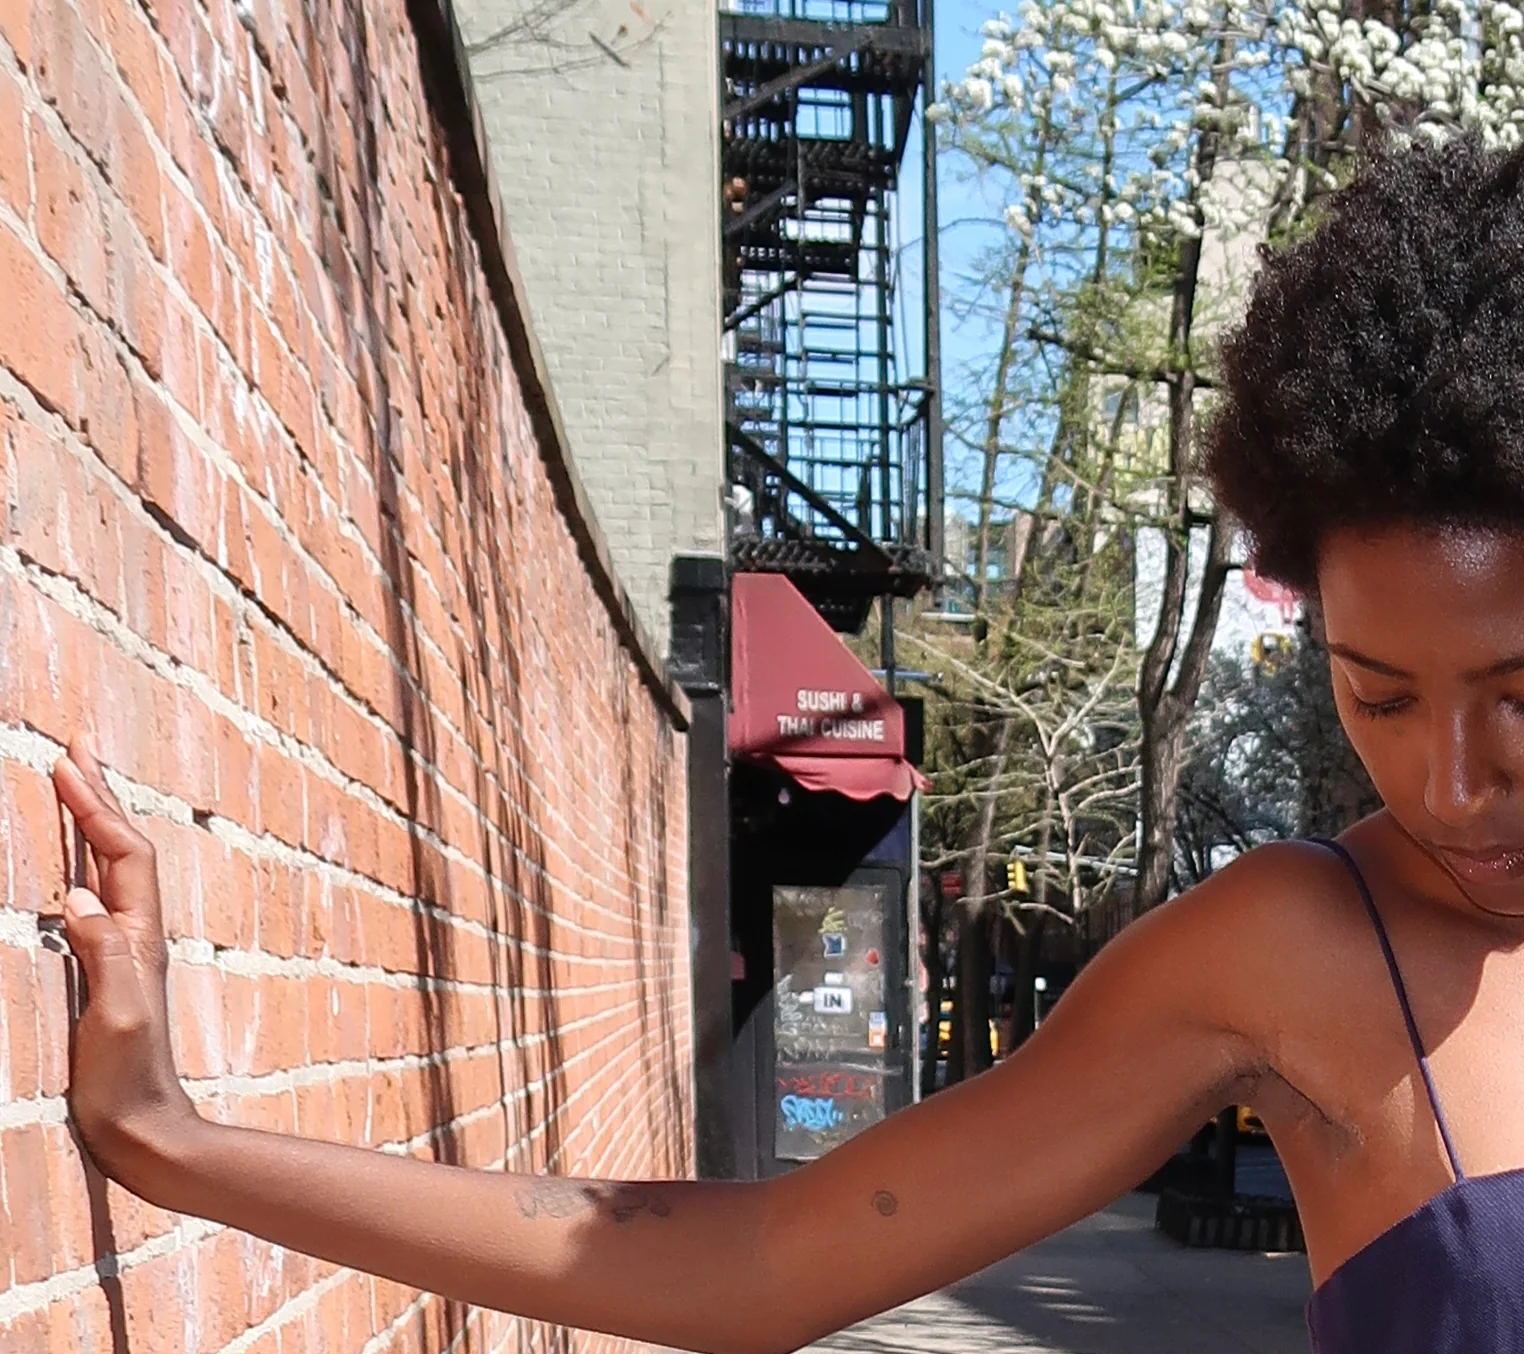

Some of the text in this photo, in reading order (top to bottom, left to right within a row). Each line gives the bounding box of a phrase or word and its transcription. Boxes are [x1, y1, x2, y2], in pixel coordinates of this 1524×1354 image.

[797, 690, 863, 712] SUSHI &
[777, 714, 884, 740] THAI CUISINE
[823, 993, 842, 1008] IN
